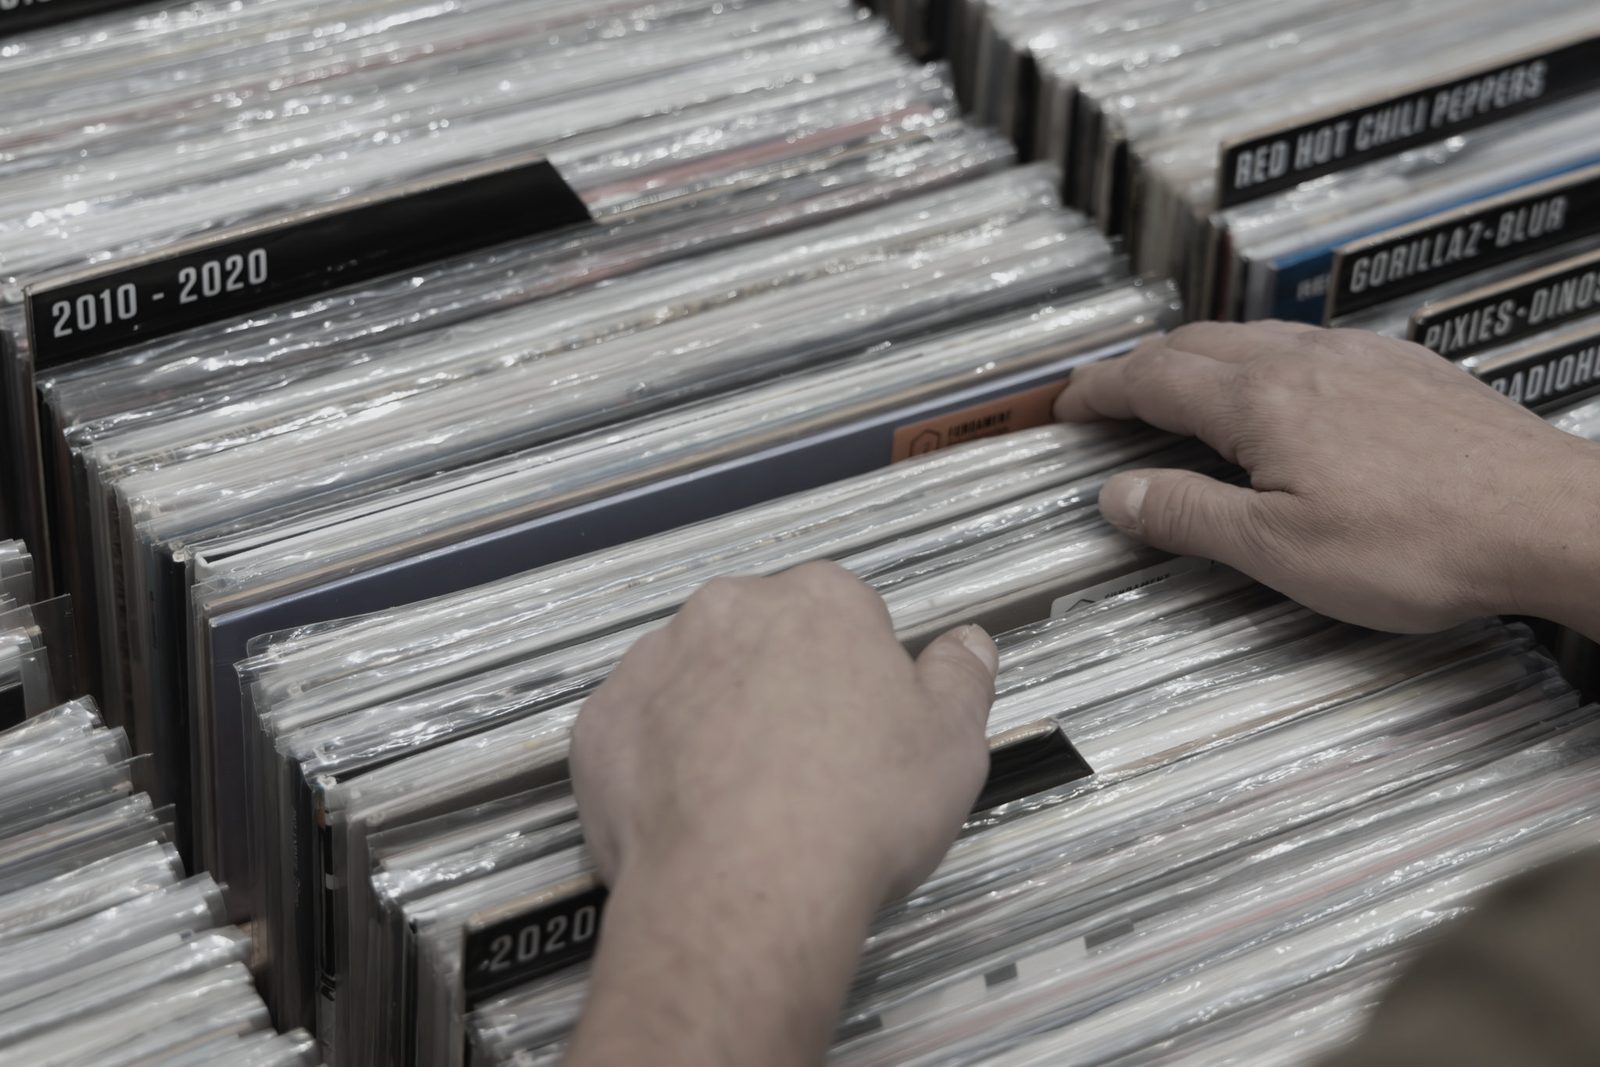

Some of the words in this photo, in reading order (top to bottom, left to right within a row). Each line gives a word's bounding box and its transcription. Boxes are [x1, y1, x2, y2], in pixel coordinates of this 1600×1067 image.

[1234, 140, 1289, 189] RED
[1295, 124, 1352, 169] HOT
[1354, 100, 1429, 152] CHILI
[1431, 61, 1548, 129] PEPPERS
[51, 282, 138, 338] 2010
[178, 247, 268, 304] 2020
